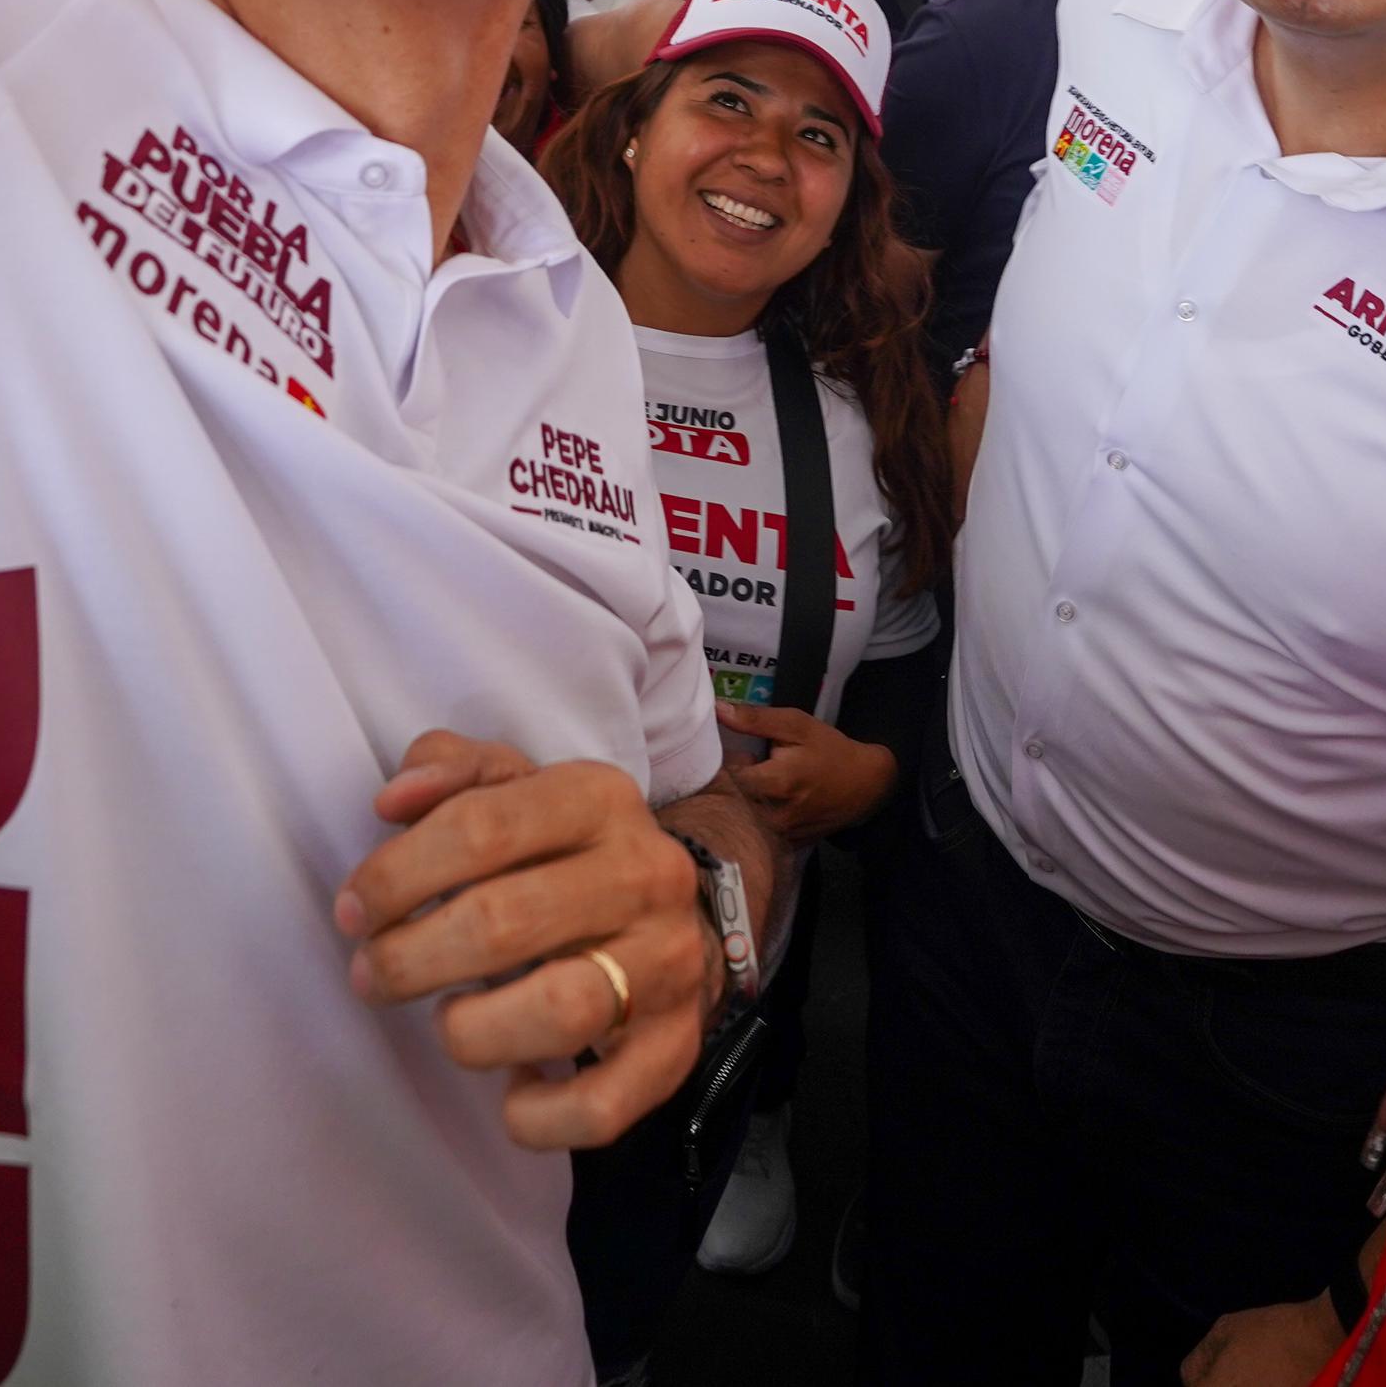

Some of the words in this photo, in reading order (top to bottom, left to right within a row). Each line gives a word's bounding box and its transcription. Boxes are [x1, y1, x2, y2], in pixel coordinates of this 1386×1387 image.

[1064, 104, 1137, 176] morena
[172, 125, 255, 215] POR
[263, 200, 309, 266] LA
[129, 128, 332, 335] PUEBLA
[195, 229, 324, 361] FUTURO
[541, 422, 604, 475] PEPE
[509, 457, 637, 526] CHEDRAUI
[673, 565, 776, 607] ADOR
[736, 652, 763, 668] EN
